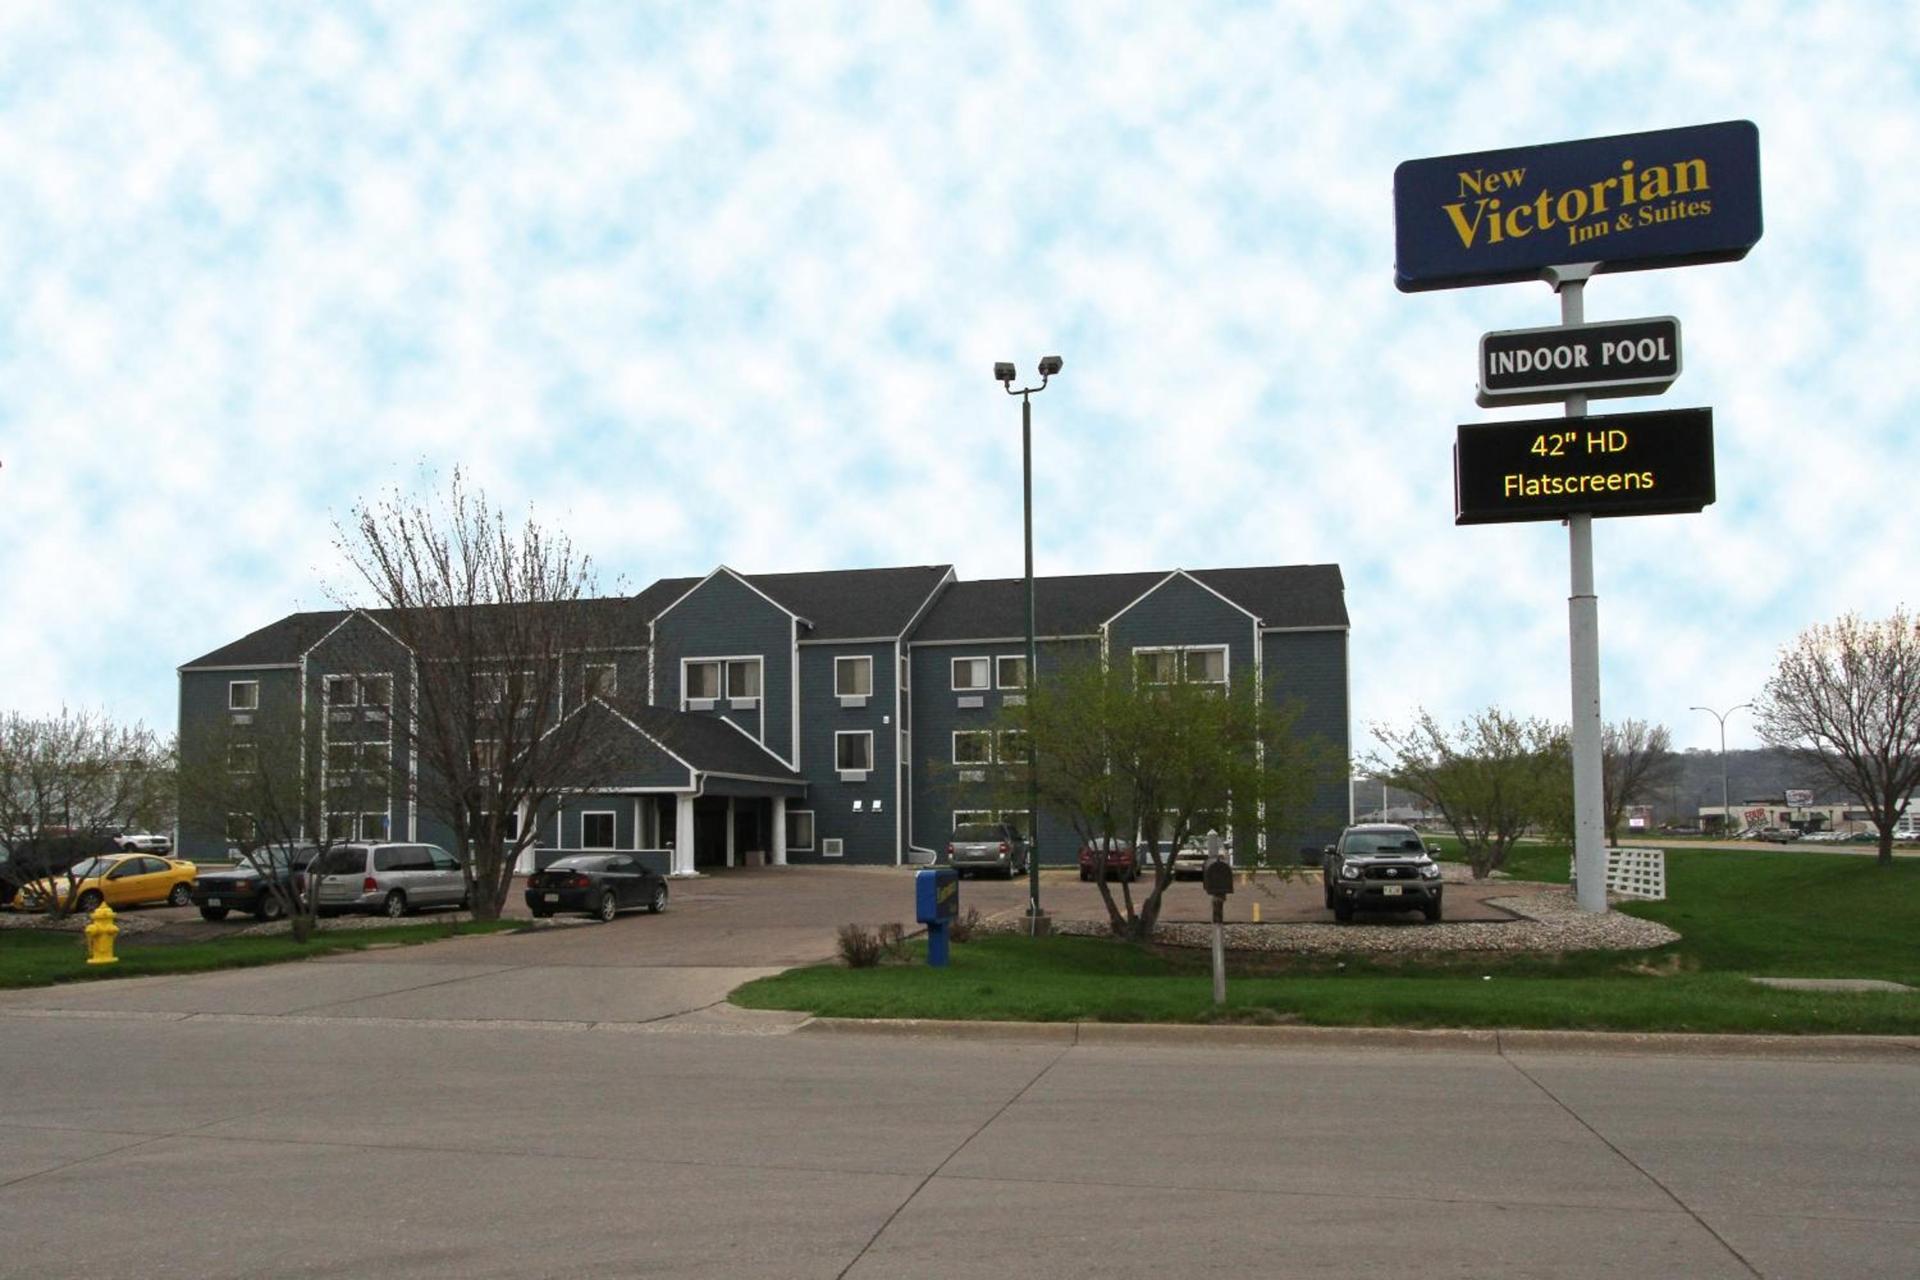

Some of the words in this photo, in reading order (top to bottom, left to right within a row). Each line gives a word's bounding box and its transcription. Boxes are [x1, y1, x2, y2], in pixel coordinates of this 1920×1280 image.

[1458, 168, 1526, 197] New
[1443, 158, 1710, 248] Victorian
[1568, 221, 1610, 246] Inn
[1614, 213, 1632, 232] &
[1638, 200, 1712, 226] Suites
[1490, 344, 1589, 375] INDOOR
[1602, 337, 1670, 365] POOL
[1530, 431, 1577, 457] 42"
[1587, 430, 1628, 454] HD
[1504, 471, 1654, 497] Flatscreens
